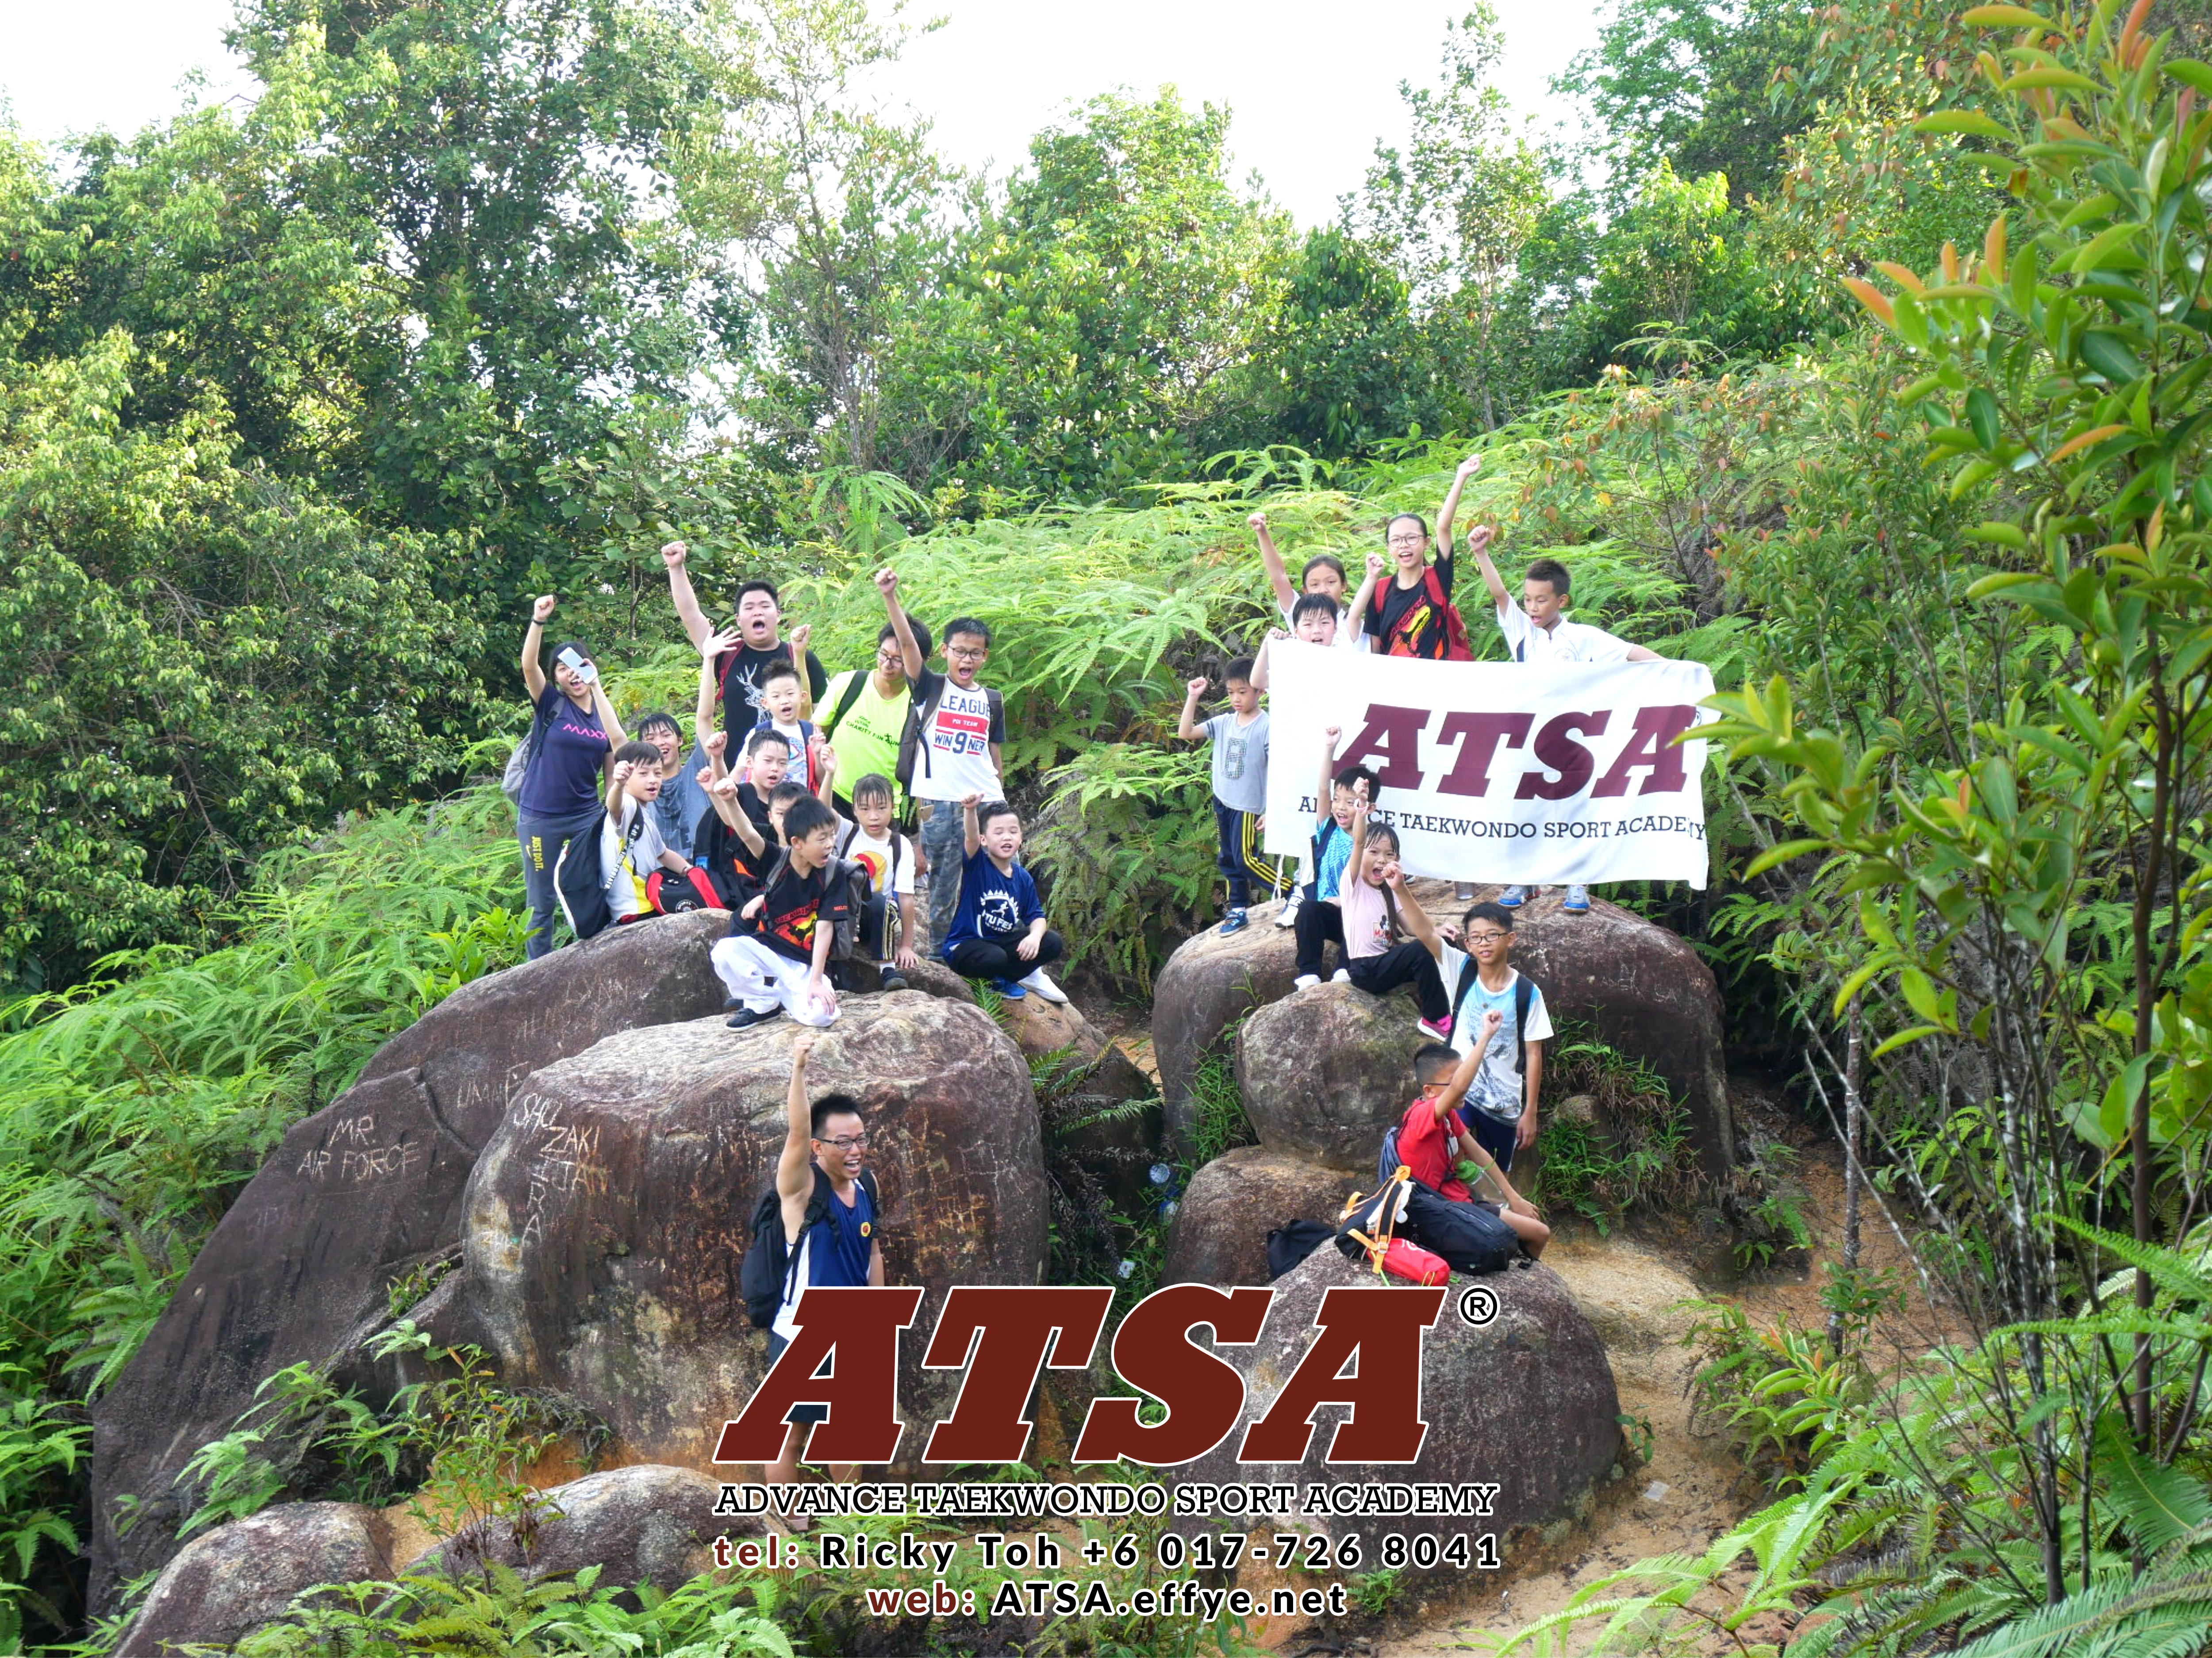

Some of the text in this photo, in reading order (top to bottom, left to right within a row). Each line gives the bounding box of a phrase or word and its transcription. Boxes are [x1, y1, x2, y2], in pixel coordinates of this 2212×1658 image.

[935, 732, 985, 754] WIN 9 NER
[1331, 703, 1697, 800] ATSA
[1400, 812, 1537, 839] TAEKWONDO
[1544, 821, 1611, 838] SPORT
[532, 836, 541, 852] JUST
[533, 852, 543, 862] DO
[539, 1124, 602, 1160] ZAKI
[296, 1141, 421, 1182] AIR FORCE
